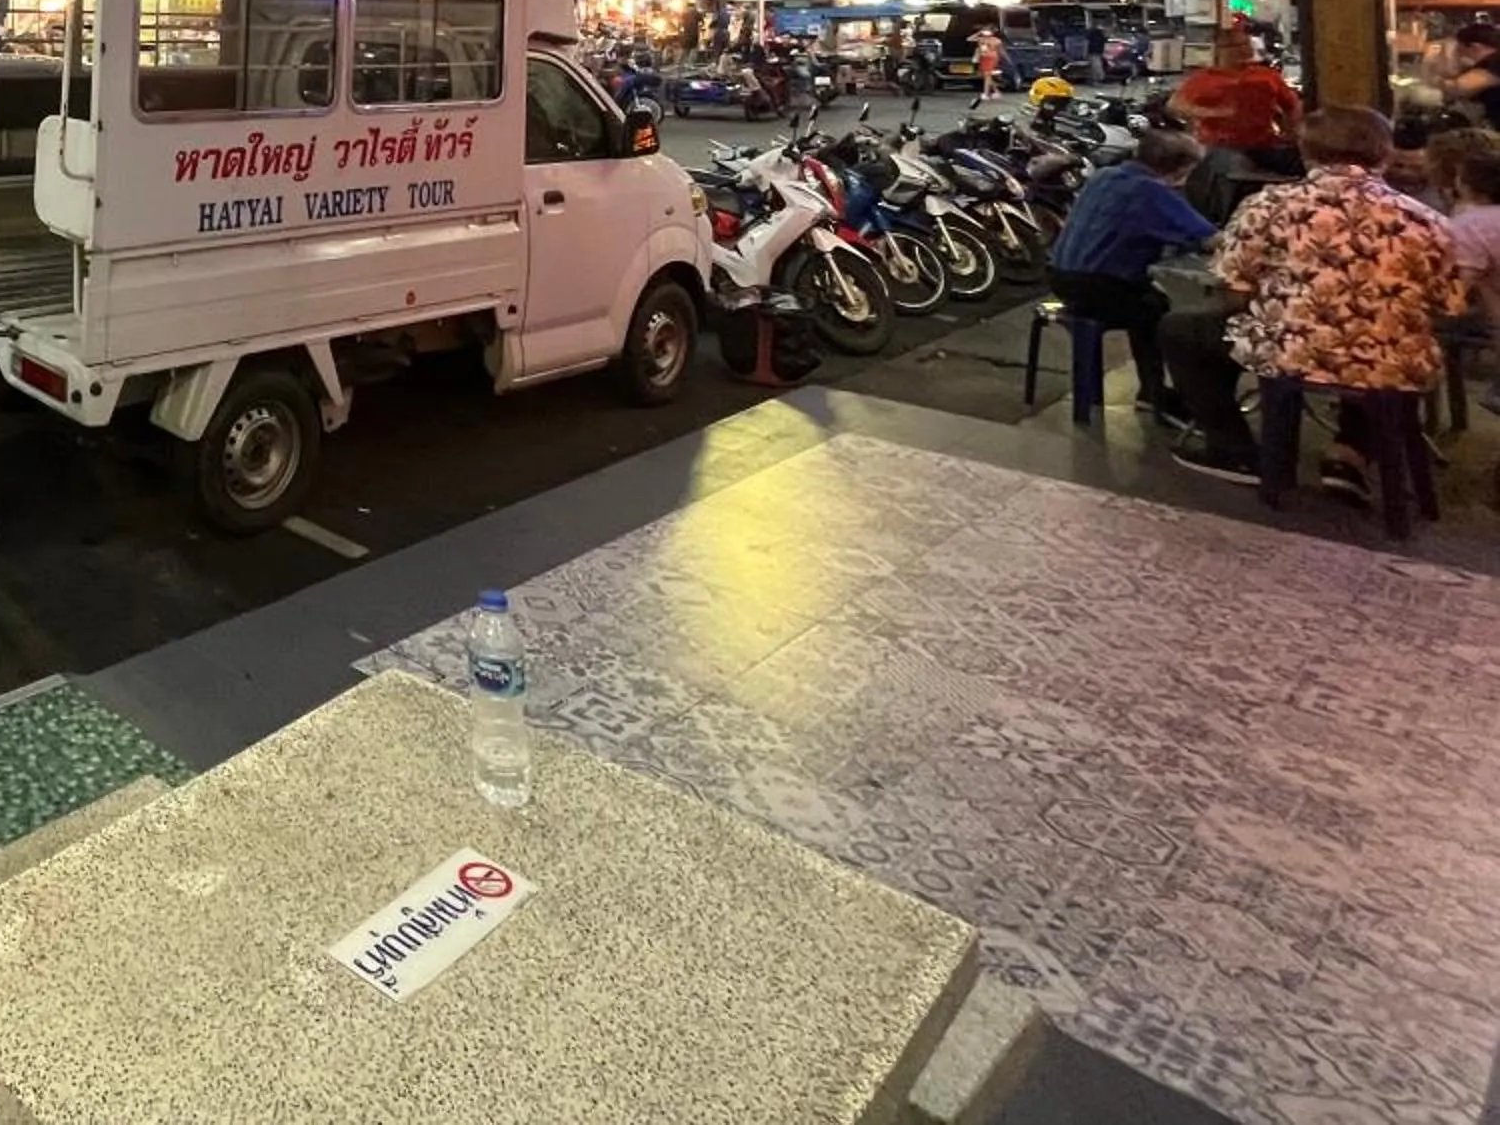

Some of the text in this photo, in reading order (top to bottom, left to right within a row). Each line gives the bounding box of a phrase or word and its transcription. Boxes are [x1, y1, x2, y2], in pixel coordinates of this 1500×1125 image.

[174, 132, 317, 183] หาดใหญ่
[198, 180, 455, 232] HATYAI VARIETY TOUR
[353, 882, 486, 993] ห้ามสูบบุหรี่
